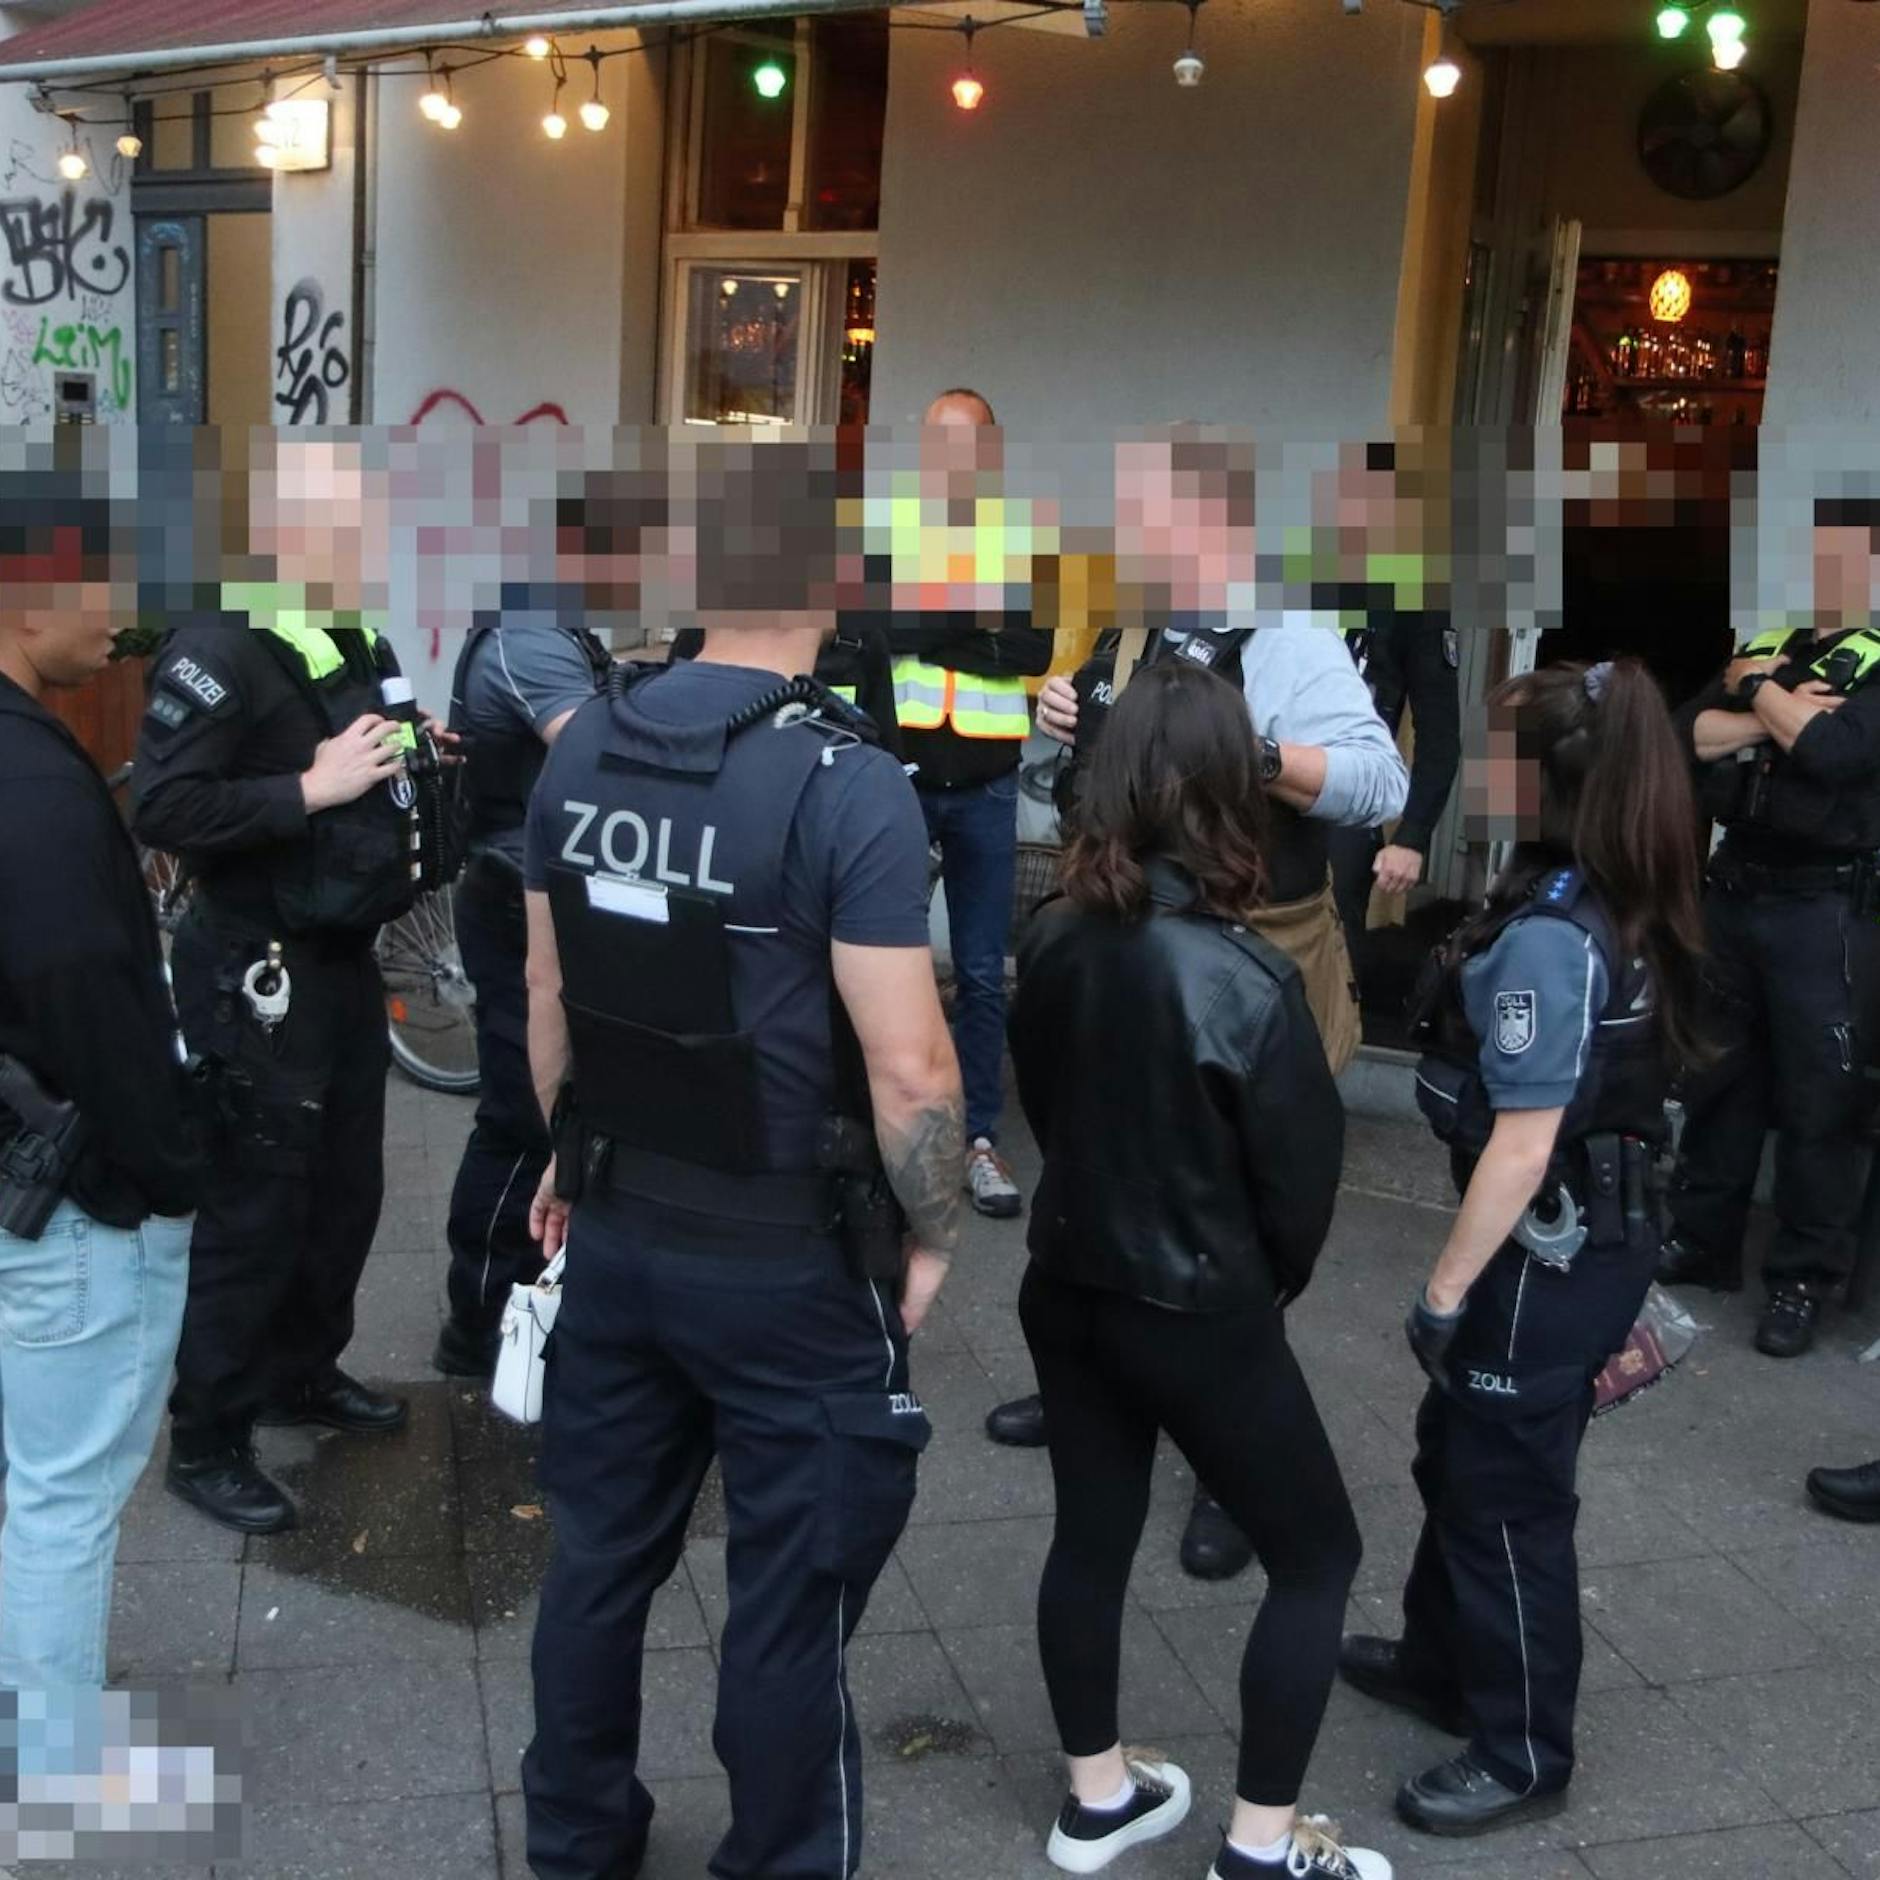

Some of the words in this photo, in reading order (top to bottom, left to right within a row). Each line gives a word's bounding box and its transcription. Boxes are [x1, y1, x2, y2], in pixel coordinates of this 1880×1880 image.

[171, 656, 227, 706] POLIZEI
[561, 799, 734, 894] ZOLL
[1499, 994, 1528, 1008] ZOLL
[1467, 1369, 1518, 1394] ZOLL
[888, 1392, 923, 1414] ZOLL
